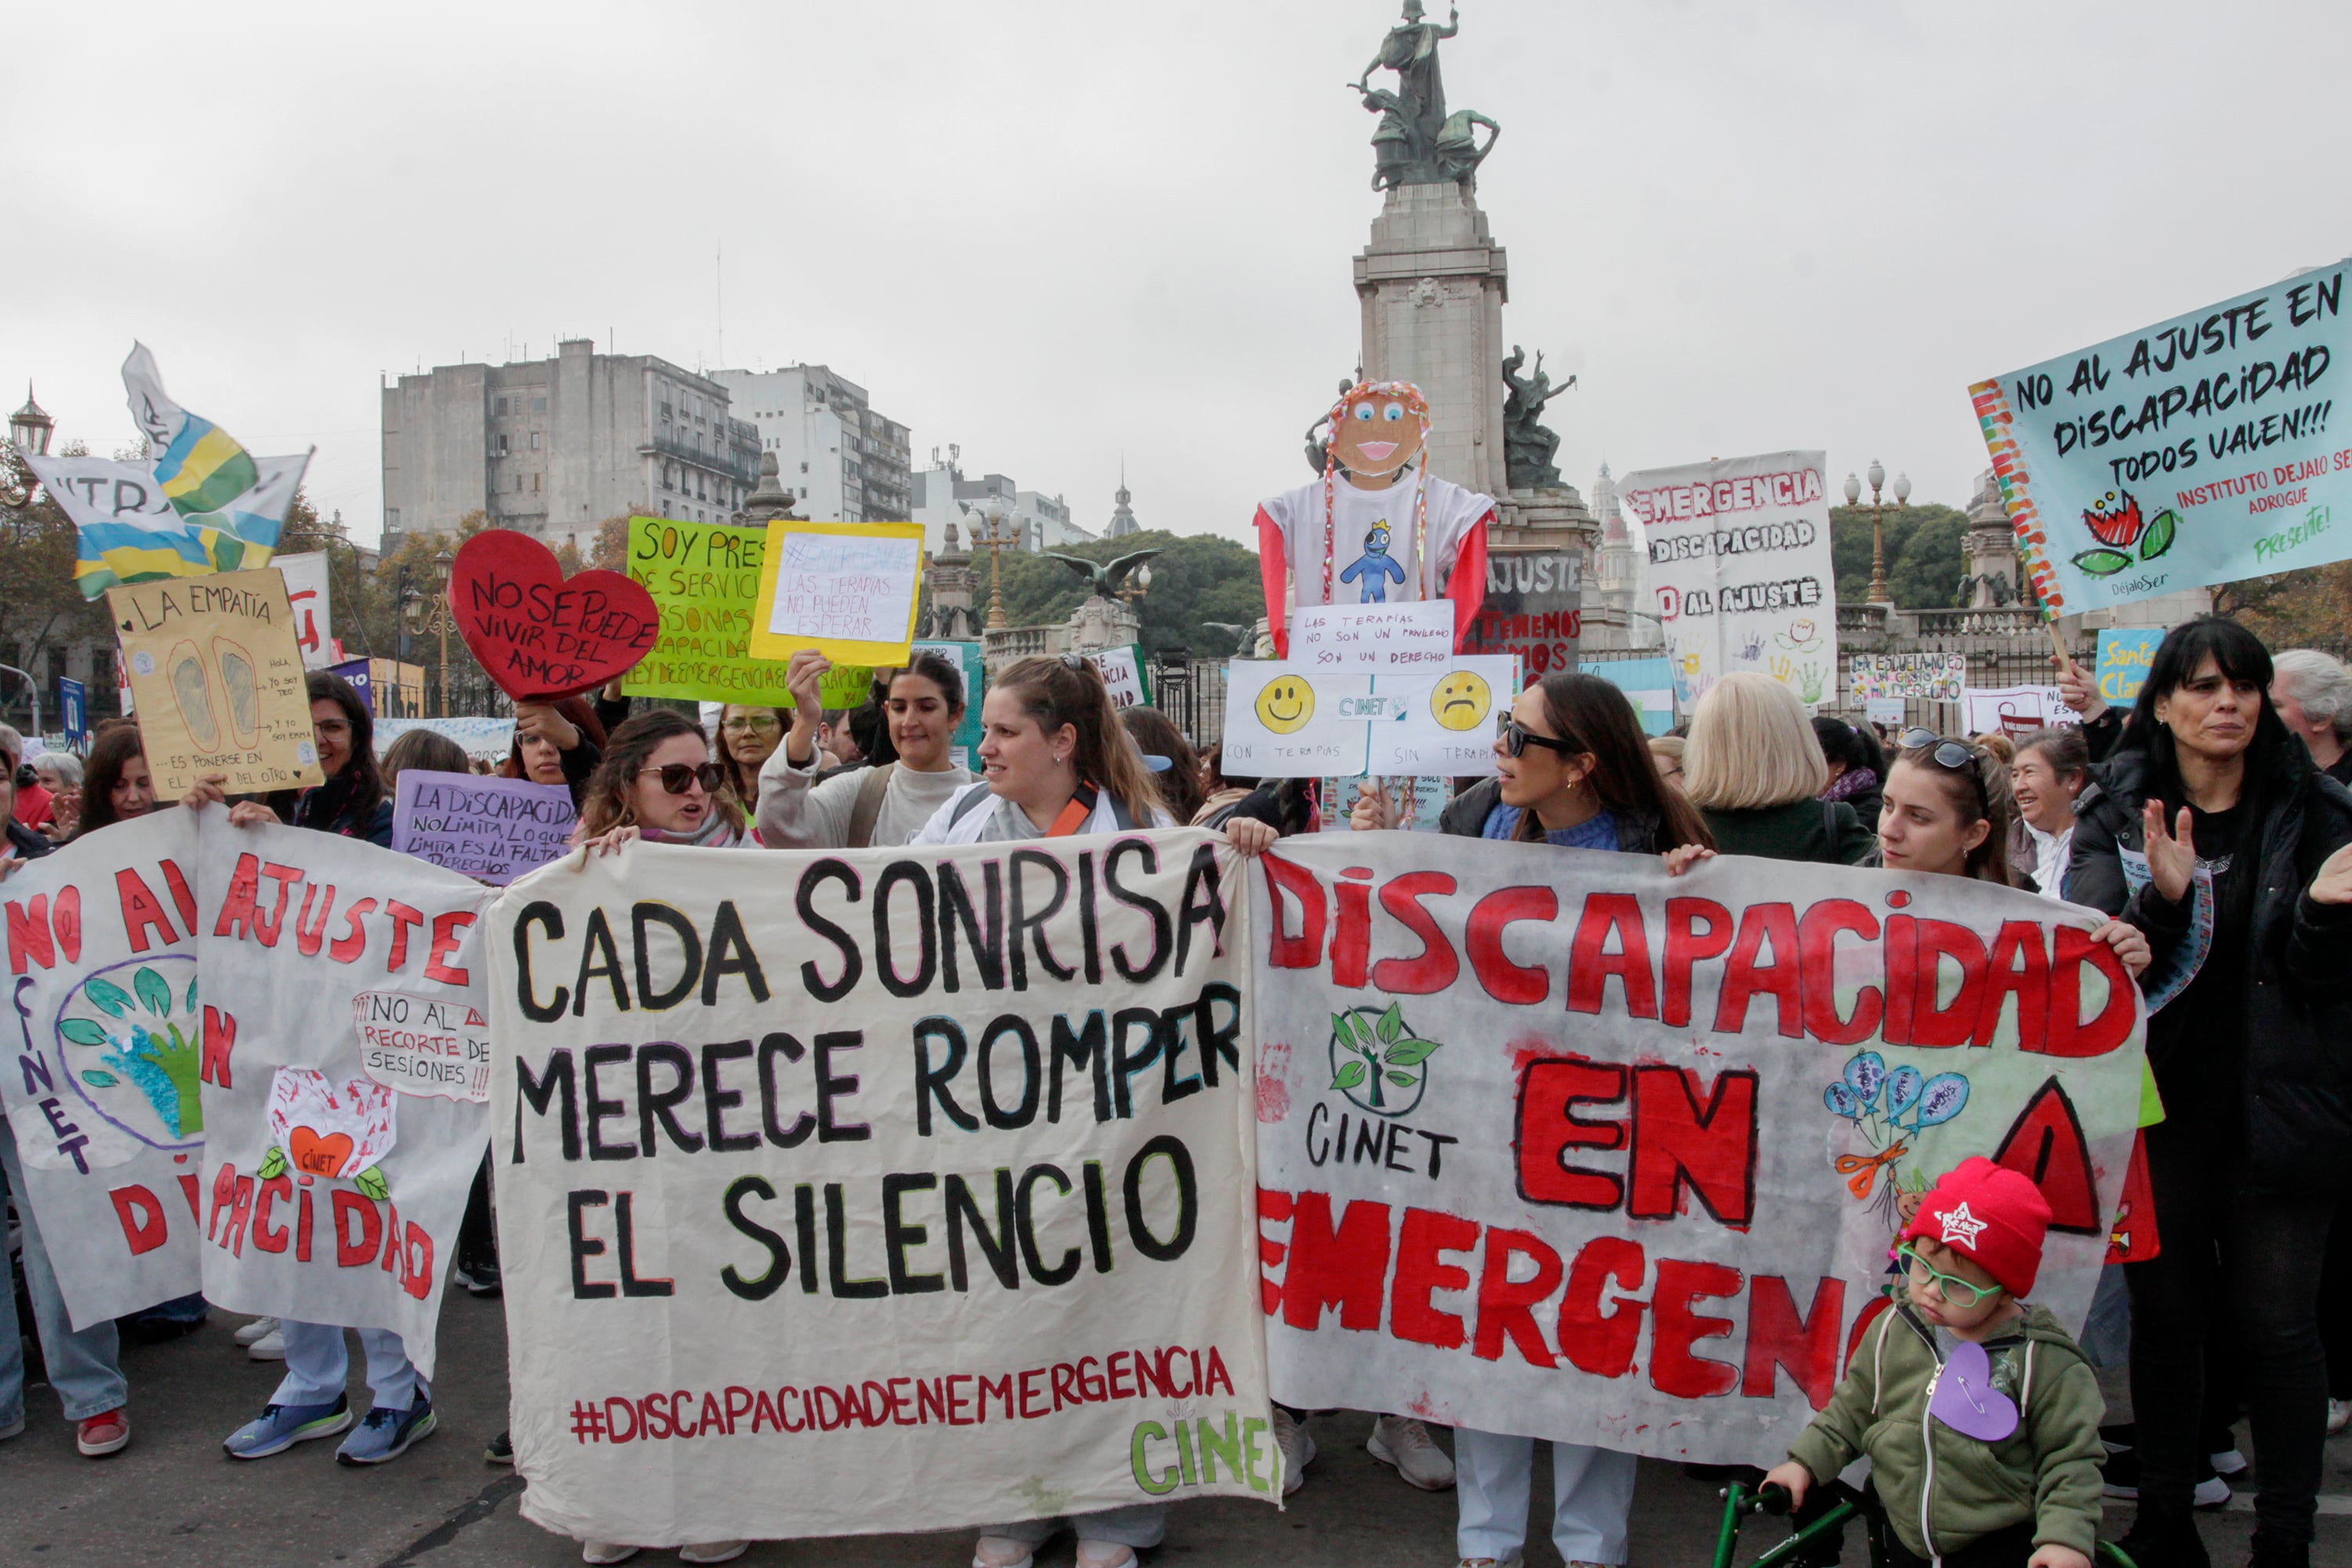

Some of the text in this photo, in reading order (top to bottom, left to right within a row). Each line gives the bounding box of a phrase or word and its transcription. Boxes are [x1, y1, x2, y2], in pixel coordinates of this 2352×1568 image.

[2016, 272, 2343, 412] NO AL AJUSTE EN
[2109, 400, 2332, 488] TODOS VALEN!!!
[2176, 471, 2268, 509] INSTITUTO
[2334, 448, 2352, 472] SE
[2249, 487, 2307, 514] ADROGUE
[637, 523, 699, 566] SOY
[670, 569, 758, 598] SERVICI
[787, 574, 817, 593] LAS
[1686, 590, 1714, 615] AL
[1720, 576, 1821, 614] AJUSTE
[132, 590, 182, 630] LA
[472, 572, 658, 648] NO SE PUEDE
[787, 595, 869, 615] NO PUEDEN
[797, 615, 872, 637] ESPERAR
[1305, 617, 1326, 628] LAS
[1306, 632, 1321, 644] NO
[1336, 630, 1359, 642] SON
[1375, 628, 1391, 640] UN
[556, 633, 608, 664] DEL
[1317, 649, 1445, 665] SON UN DERECHO
[1947, 653, 1964, 670] ES
[506, 648, 587, 686] AMOR
[268, 677, 279, 688] YO
[1339, 697, 1387, 717] CINET
[274, 720, 280, 728] Y
[193, 753, 241, 768] PONERSE
[247, 751, 263, 764] EN
[1226, 744, 1253, 760] CON
[1394, 746, 1419, 764] SIN
[168, 776, 187, 789] EL
[236, 771, 255, 786] DEL
[262, 768, 287, 782] OTRO
[414, 784, 440, 811] LA
[414, 815, 441, 833] NO
[507, 825, 535, 842] LO
[427, 853, 510, 874] DERECHOS
[461, 840, 485, 855] ES
[490, 841, 505, 858] LA
[510, 844, 560, 862] FALTA
[4, 884, 81, 975] NO
[213, 852, 479, 987] AJUSTE
[514, 833, 1226, 1023] CADA SONRISA
[423, 1003, 456, 1032] AL
[365, 1025, 489, 1062] RECORTE DE
[510, 980, 1240, 1165] MERECE ROMPER
[1306, 1102, 1459, 1180] CINET
[1515, 1056, 1759, 1235] EN
[568, 1134, 1200, 1301] EL SILENCIO
[571, 1345, 1235, 1445] #DISCAPACIDADENEMERGENCIA
